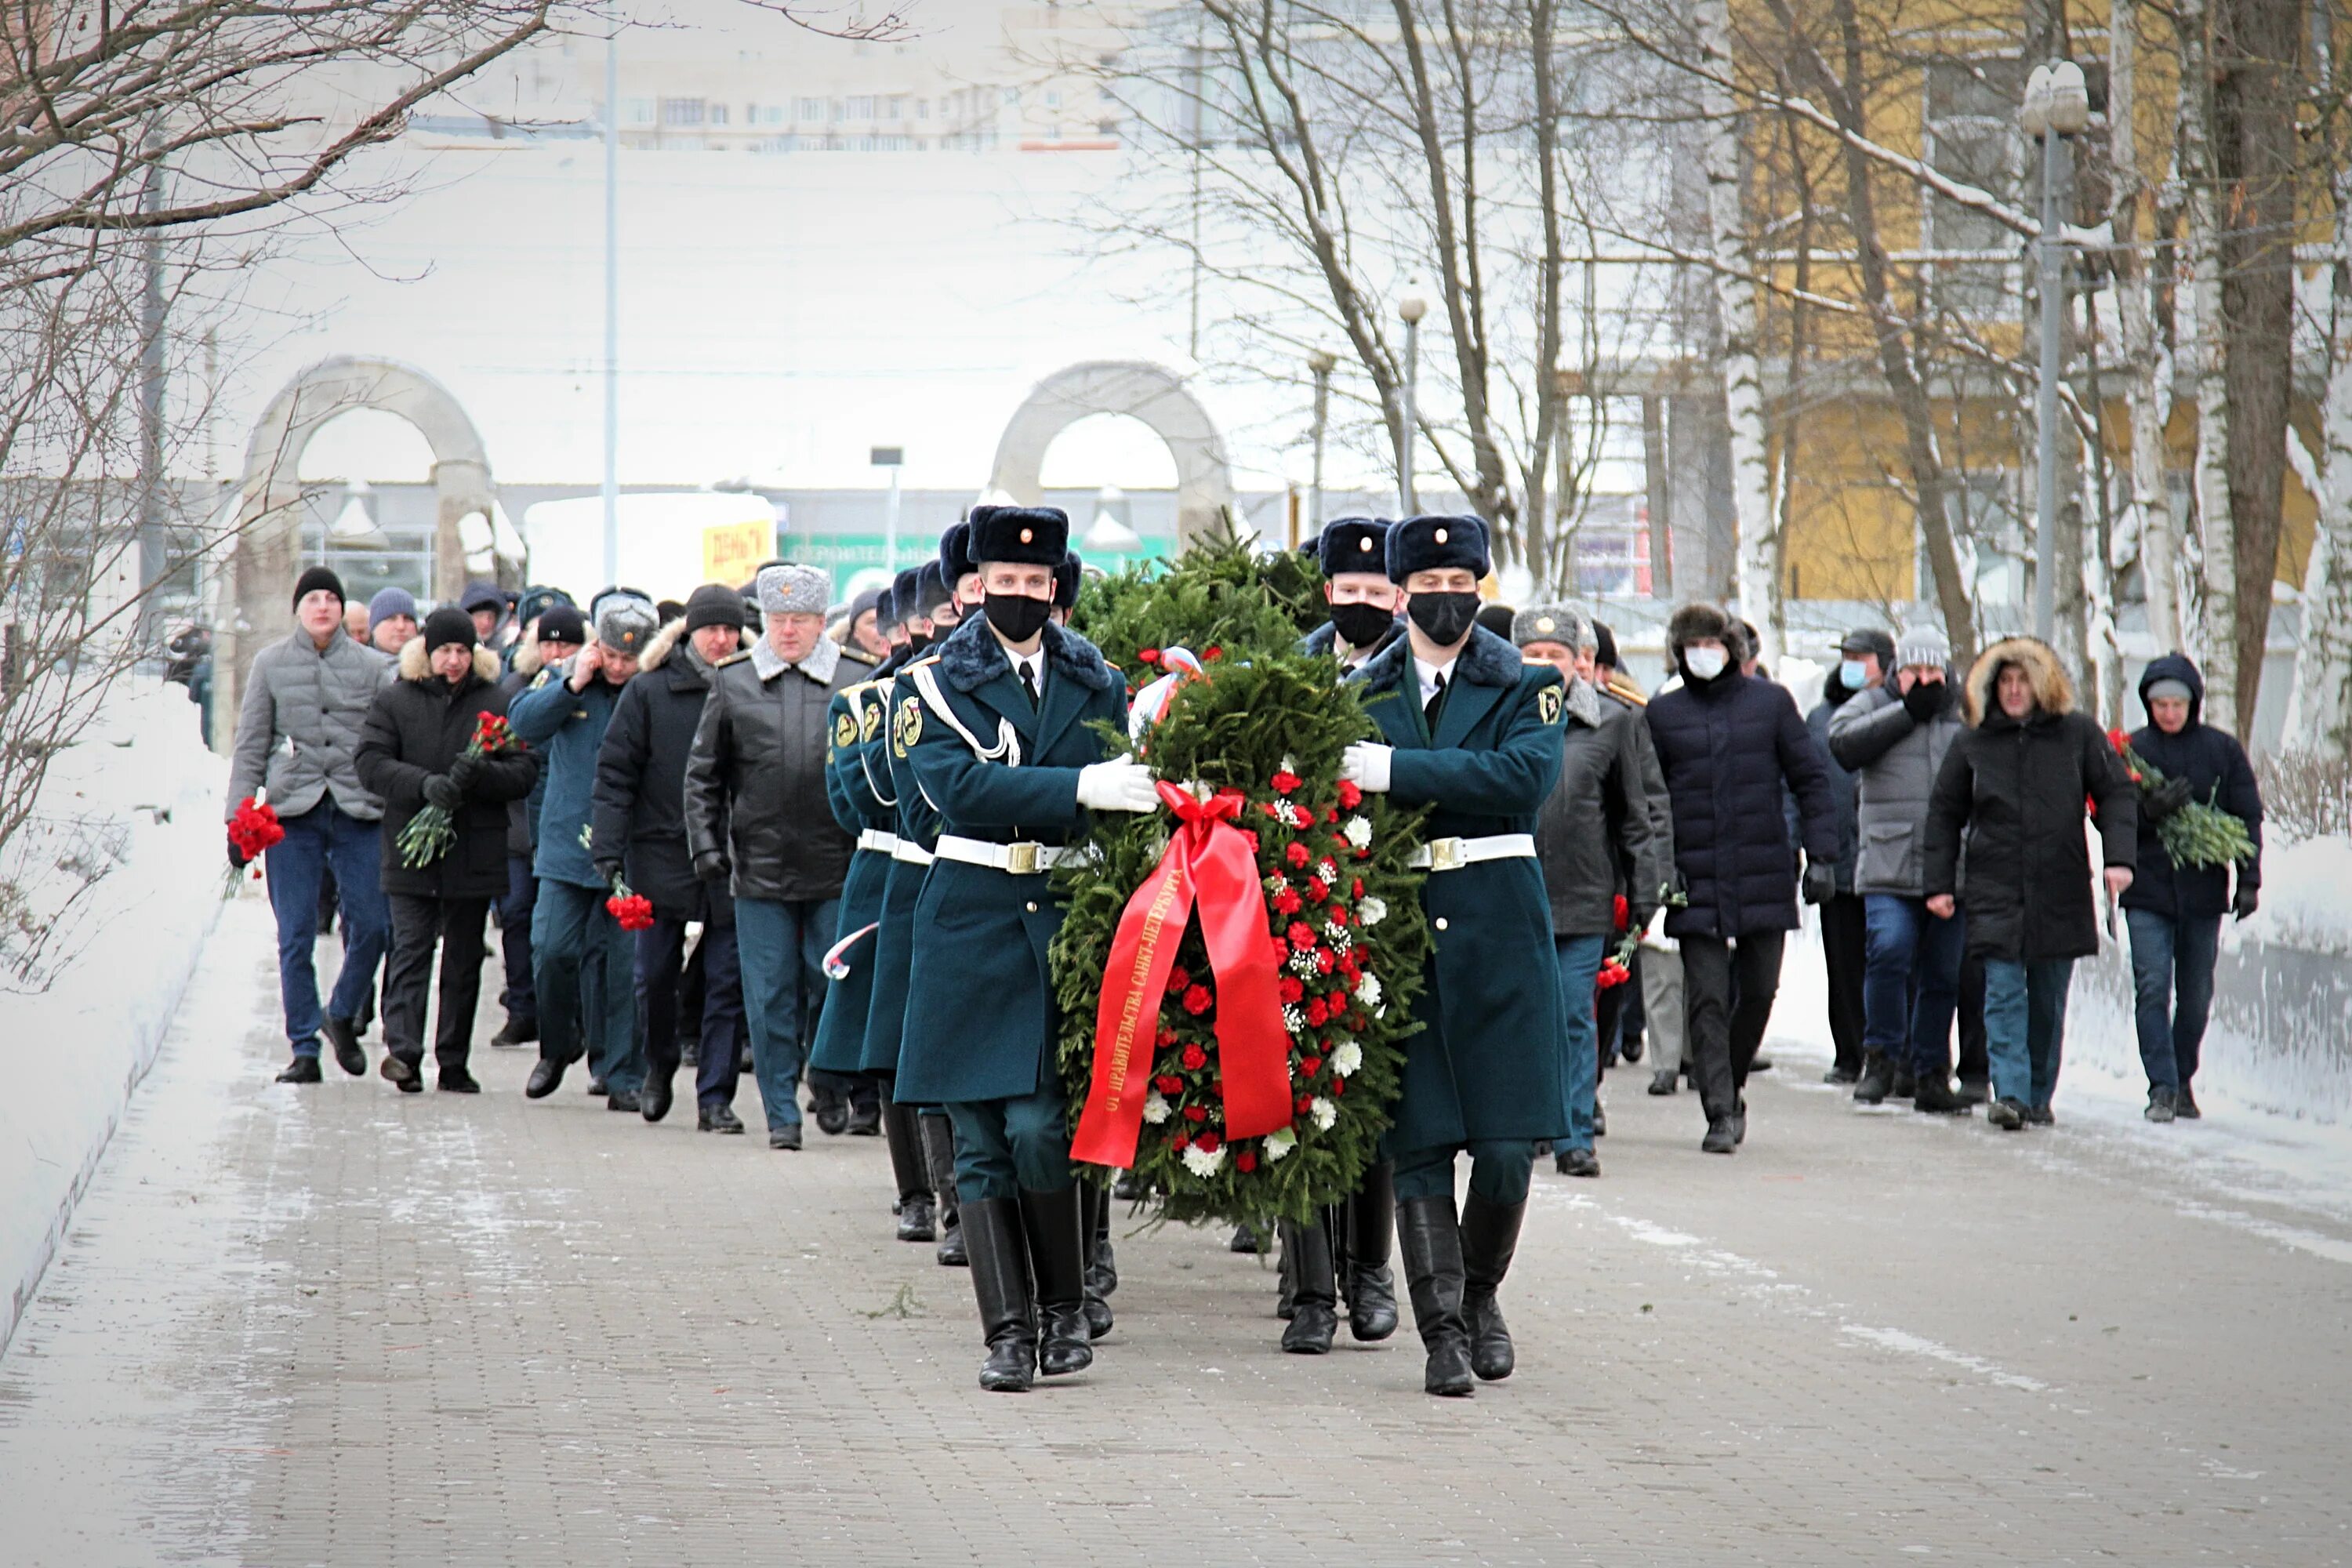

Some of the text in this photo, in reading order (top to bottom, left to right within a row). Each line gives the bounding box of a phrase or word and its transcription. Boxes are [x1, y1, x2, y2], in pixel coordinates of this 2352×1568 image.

[1105, 869, 1182, 1112] ОТ ПРАВИТЕЛЬСТВА САНКТ-ПЕТЕРБУРГА
